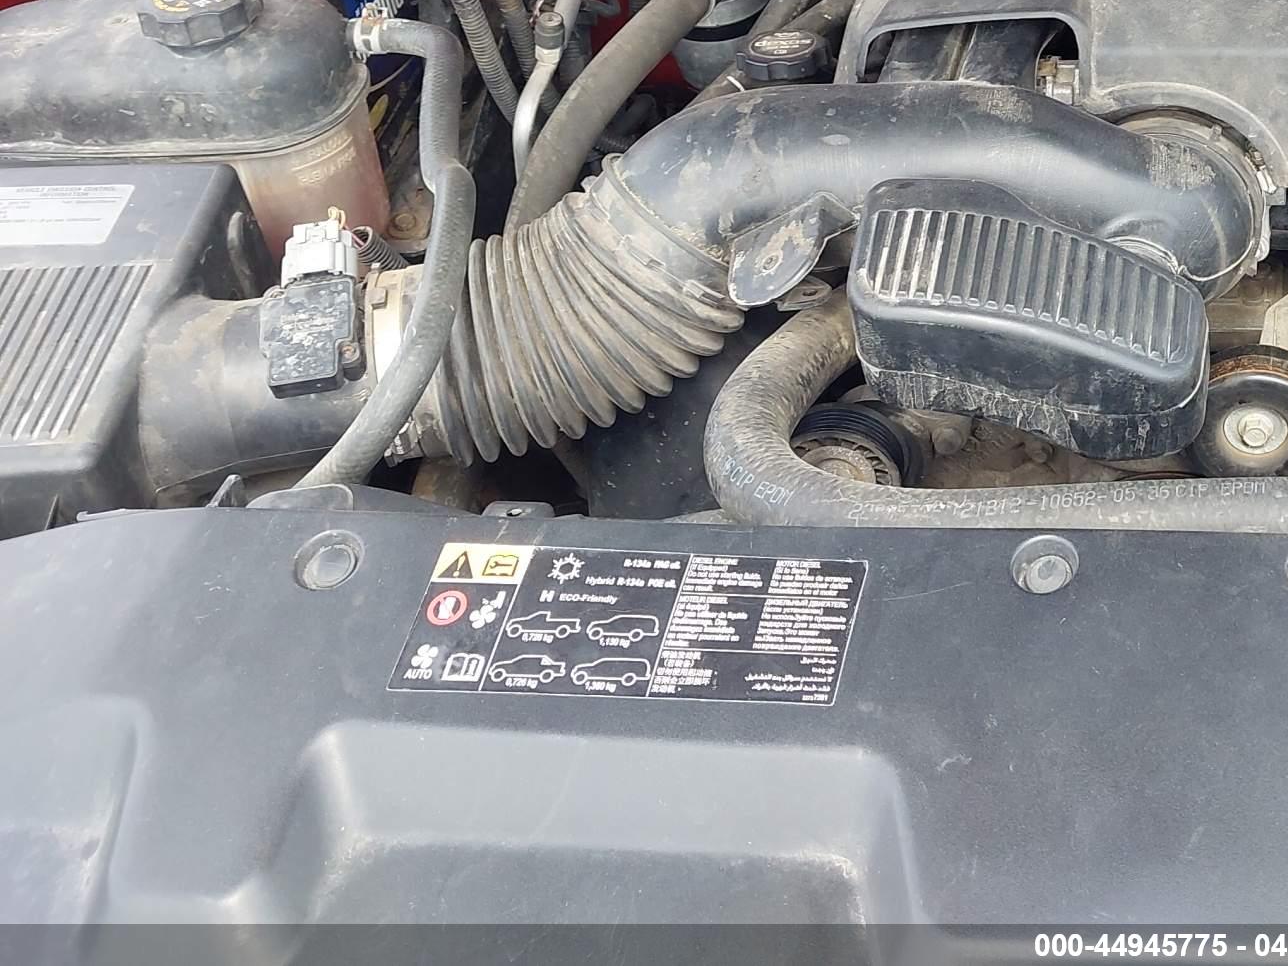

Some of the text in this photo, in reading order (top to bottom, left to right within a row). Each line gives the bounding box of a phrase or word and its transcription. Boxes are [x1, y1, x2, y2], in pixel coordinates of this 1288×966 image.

[585, 576, 615, 586] Hybrid
[559, 593, 618, 605] ECO-Friendly
[403, 669, 432, 679] AUTO
